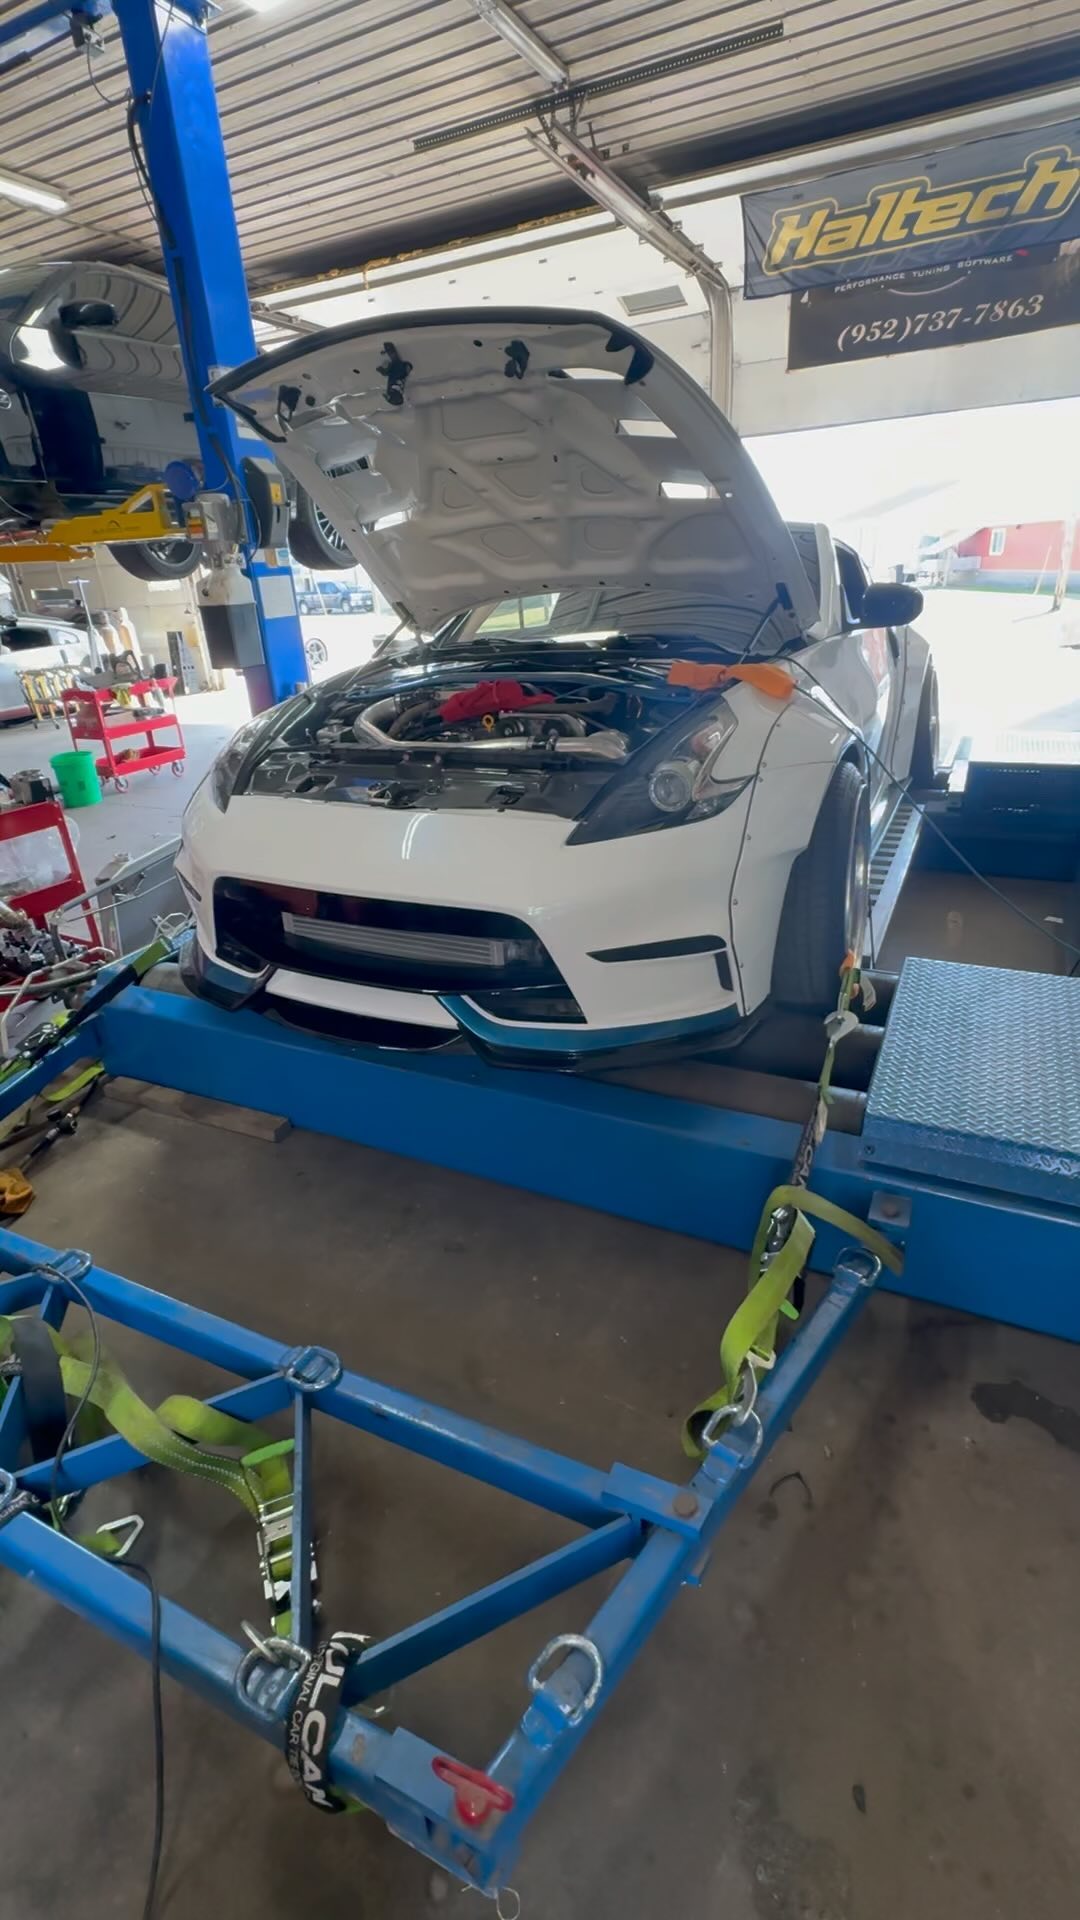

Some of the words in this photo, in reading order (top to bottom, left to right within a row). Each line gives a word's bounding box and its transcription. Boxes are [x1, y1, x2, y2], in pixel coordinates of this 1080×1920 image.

[770, 156, 1080, 266] Haltech
[834, 272, 906, 294] PERFORMANCE
[912, 264, 951, 279] TUNING
[957, 254, 1013, 269] SOFTWARE
[837, 294, 1044, 352] (952)737-7863
